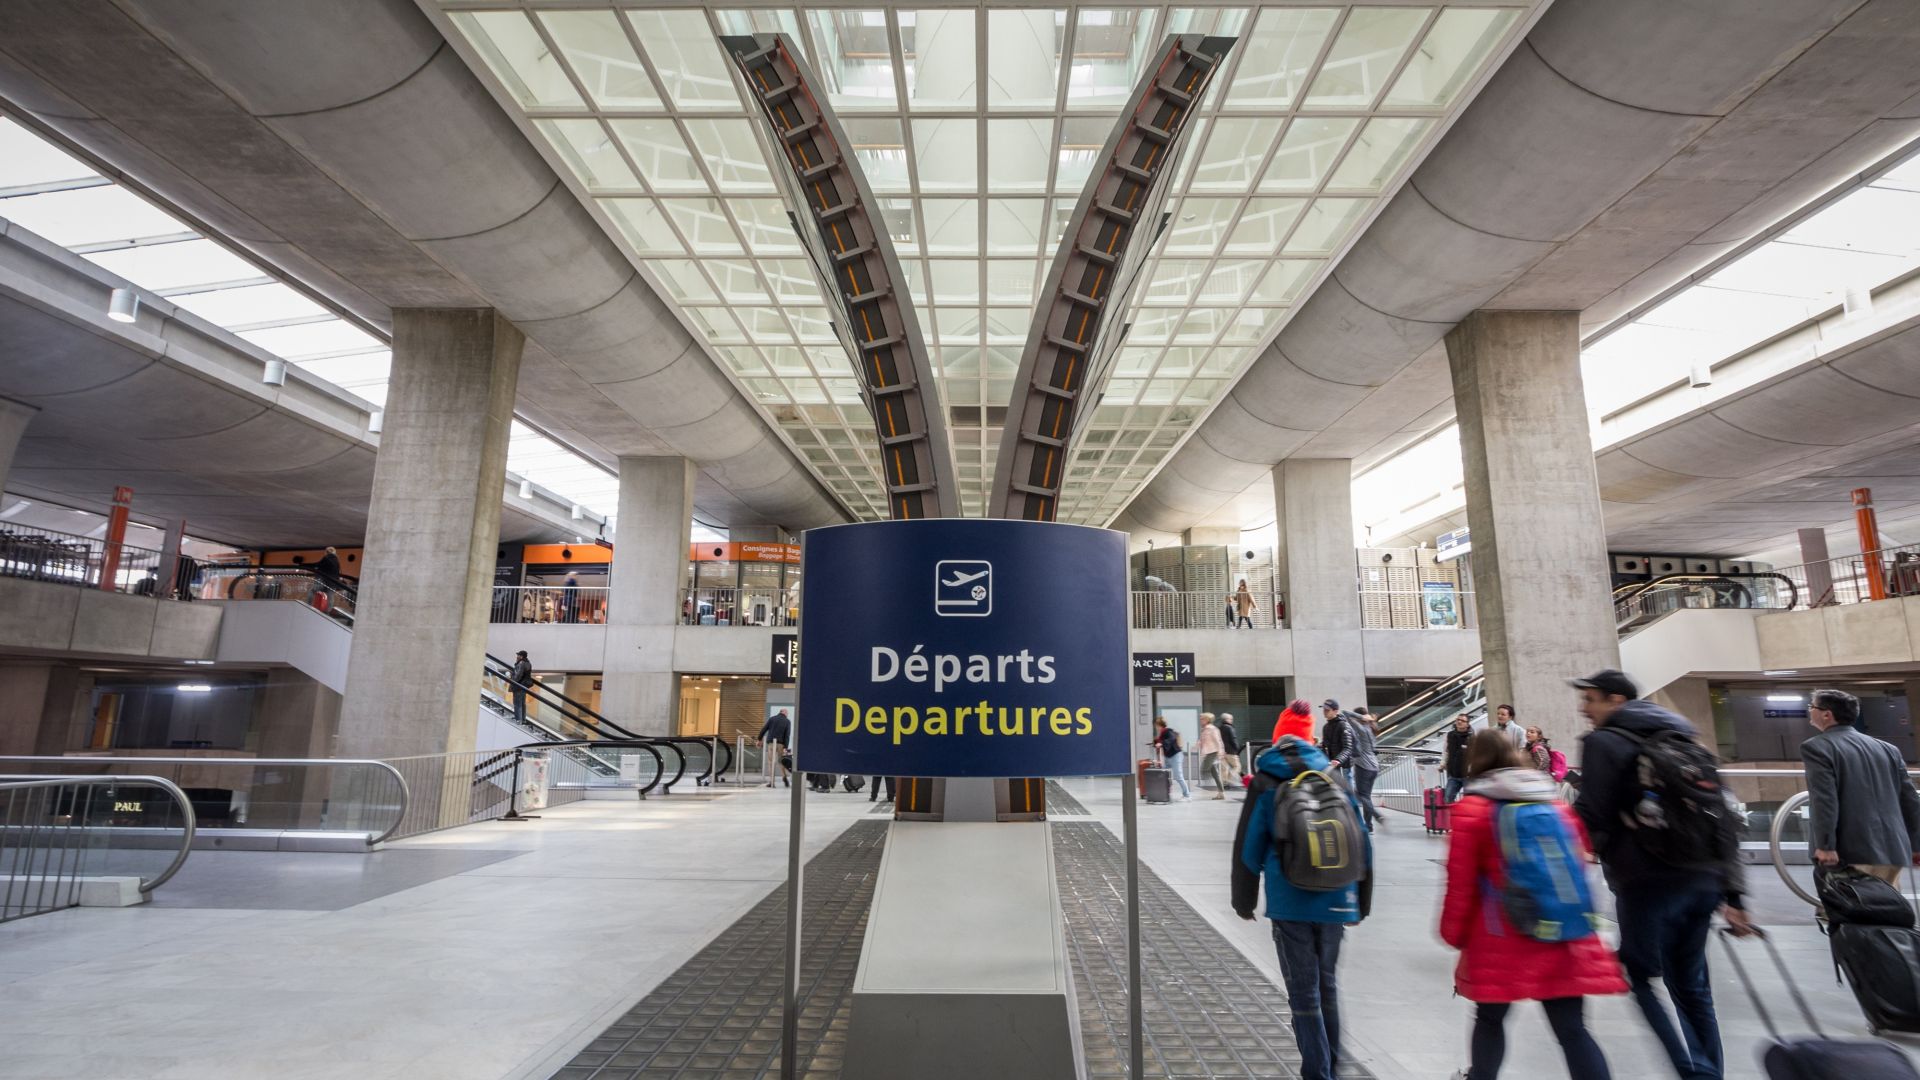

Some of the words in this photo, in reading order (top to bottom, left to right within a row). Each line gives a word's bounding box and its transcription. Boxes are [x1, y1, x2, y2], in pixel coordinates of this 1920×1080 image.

[742, 545, 778, 553] Consignes
[871, 645, 1056, 692] Départs
[835, 698, 1092, 744] Departures
[114, 802, 143, 811] PAUL
